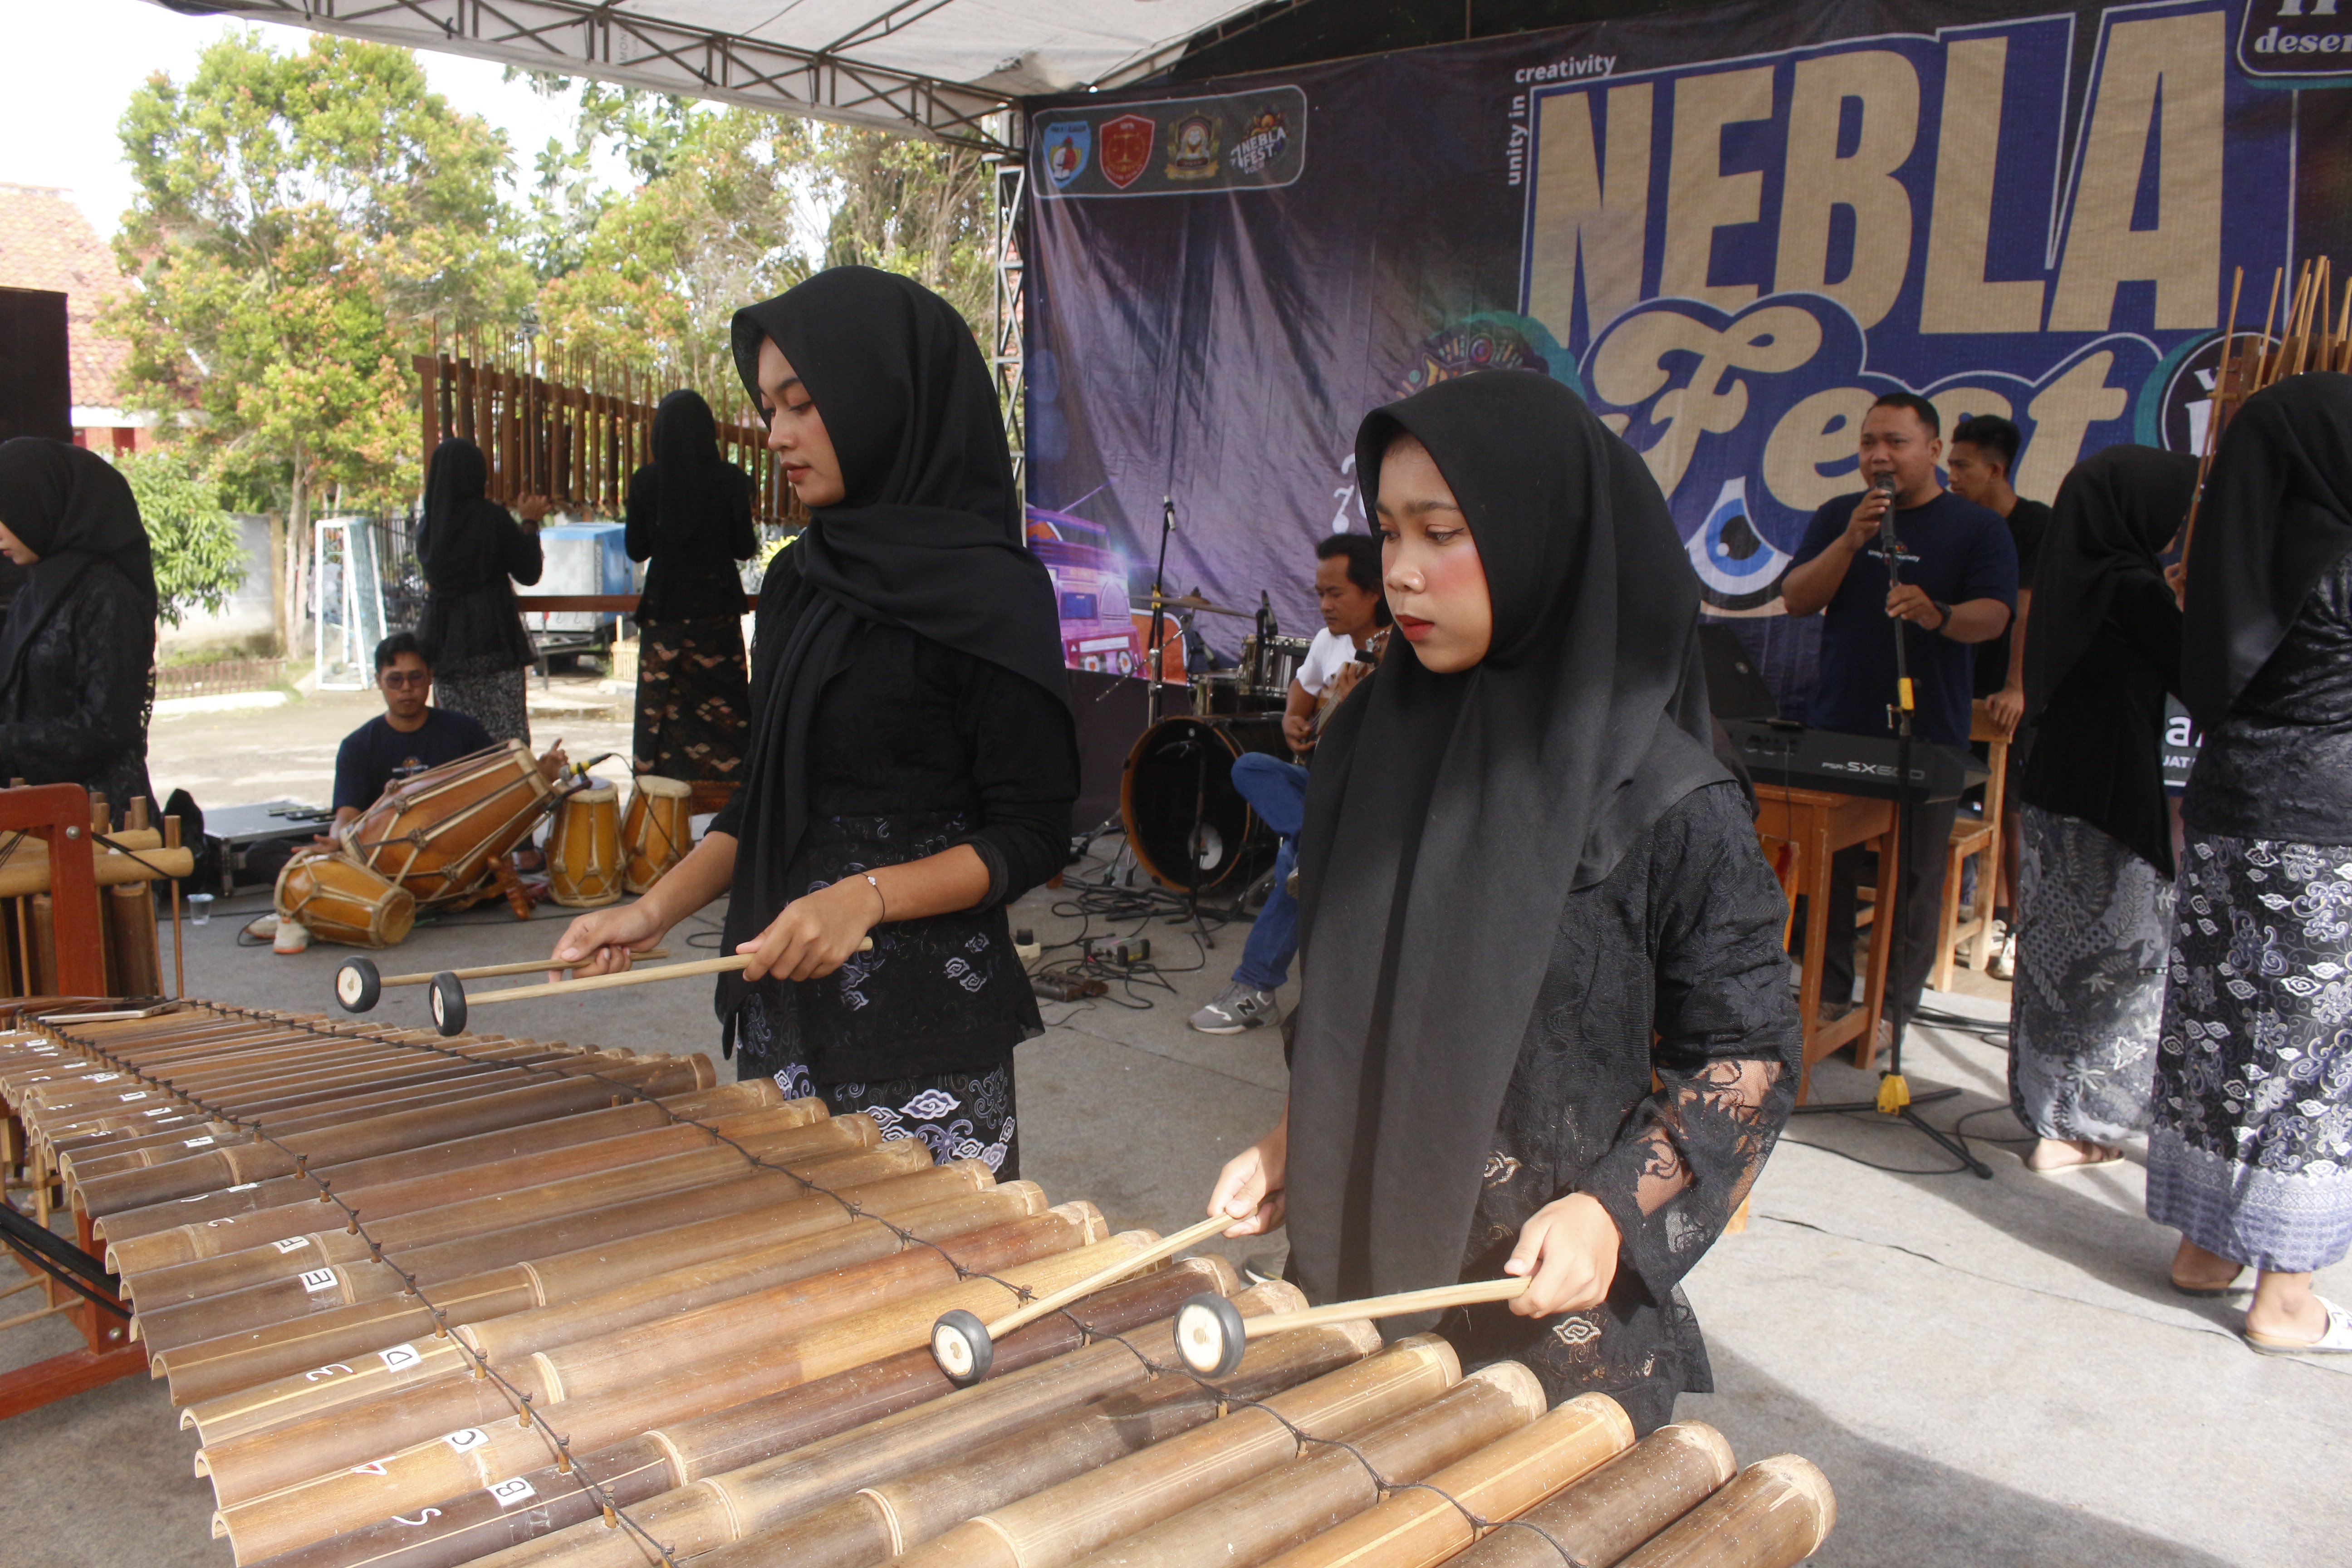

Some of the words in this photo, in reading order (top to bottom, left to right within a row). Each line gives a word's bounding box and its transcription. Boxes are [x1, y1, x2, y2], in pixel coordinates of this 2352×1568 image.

[1514, 54, 1617, 83] creativity
[1509, 94, 1525, 118] in
[1241, 126, 1287, 154] NEBLA
[1243, 143, 1274, 168] FEST
[1506, 123, 1529, 186] unity
[1528, 10, 2226, 349] NEBLA
[1235, 996, 1258, 1017] N
[305, 1270, 332, 1286] E
[305, 1363, 353, 1382] 3
[386, 1350, 413, 1366] D
[350, 1455, 397, 1476] 4
[451, 1429, 476, 1446] C
[495, 1480, 527, 1497] B
